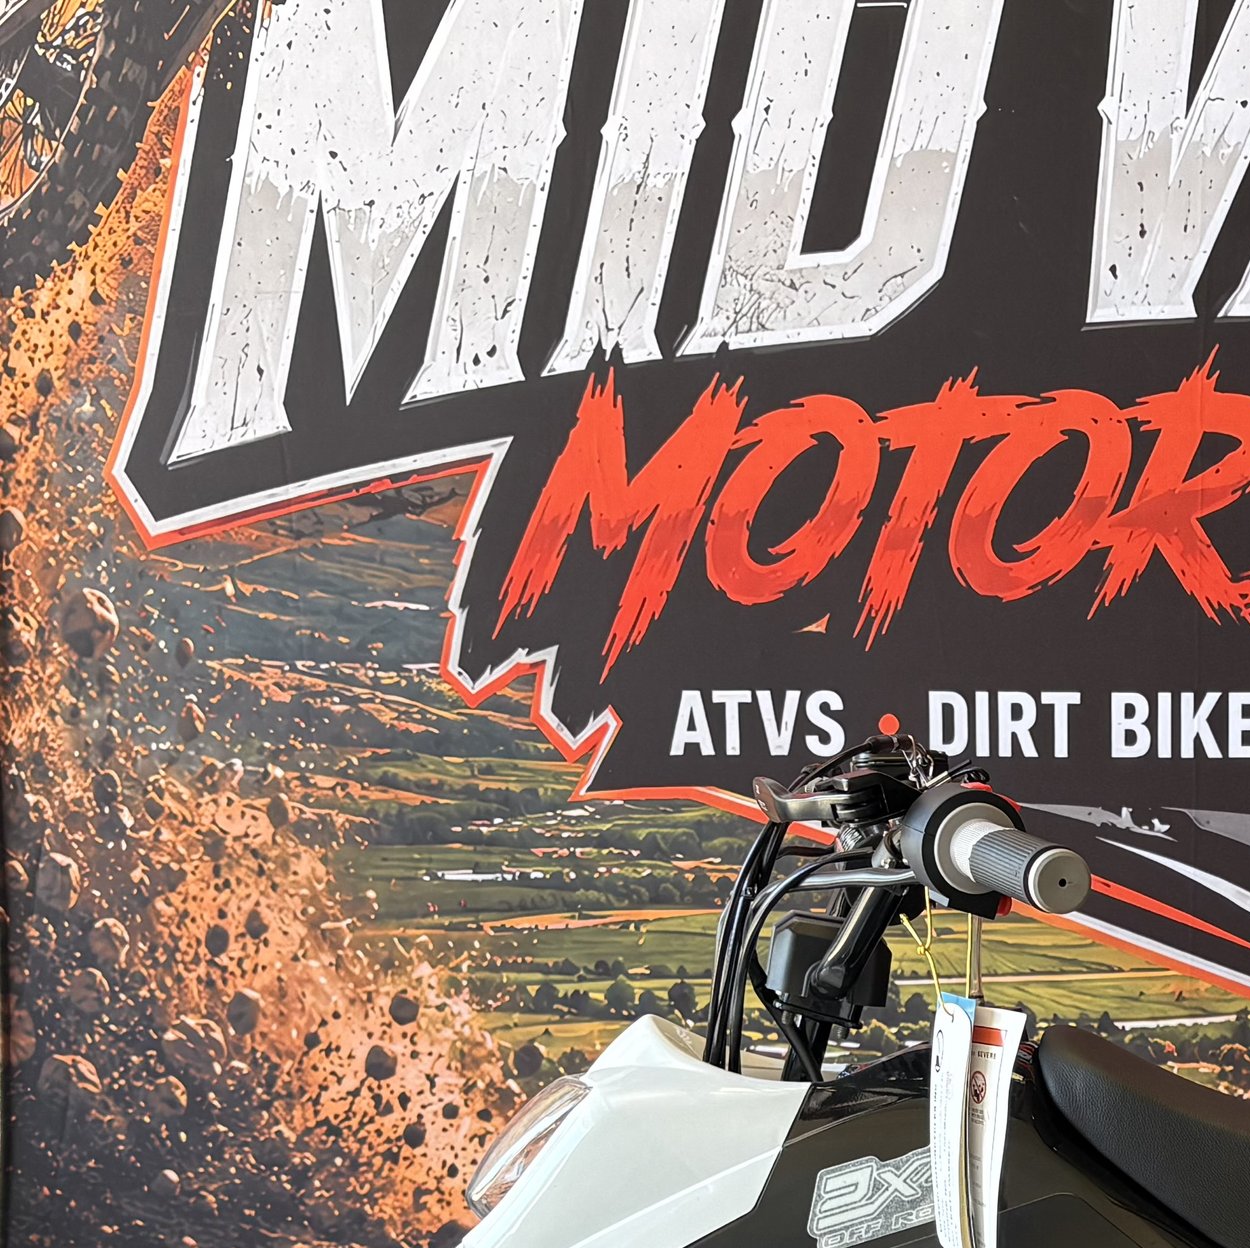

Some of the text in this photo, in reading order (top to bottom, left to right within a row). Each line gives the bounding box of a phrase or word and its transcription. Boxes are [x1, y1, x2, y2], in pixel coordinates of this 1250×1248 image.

[168, 0, 996, 468] MID
[669, 689, 847, 758] ATVS
[927, 690, 1082, 758] DIRT
[822, 1219, 883, 1248] OFF
